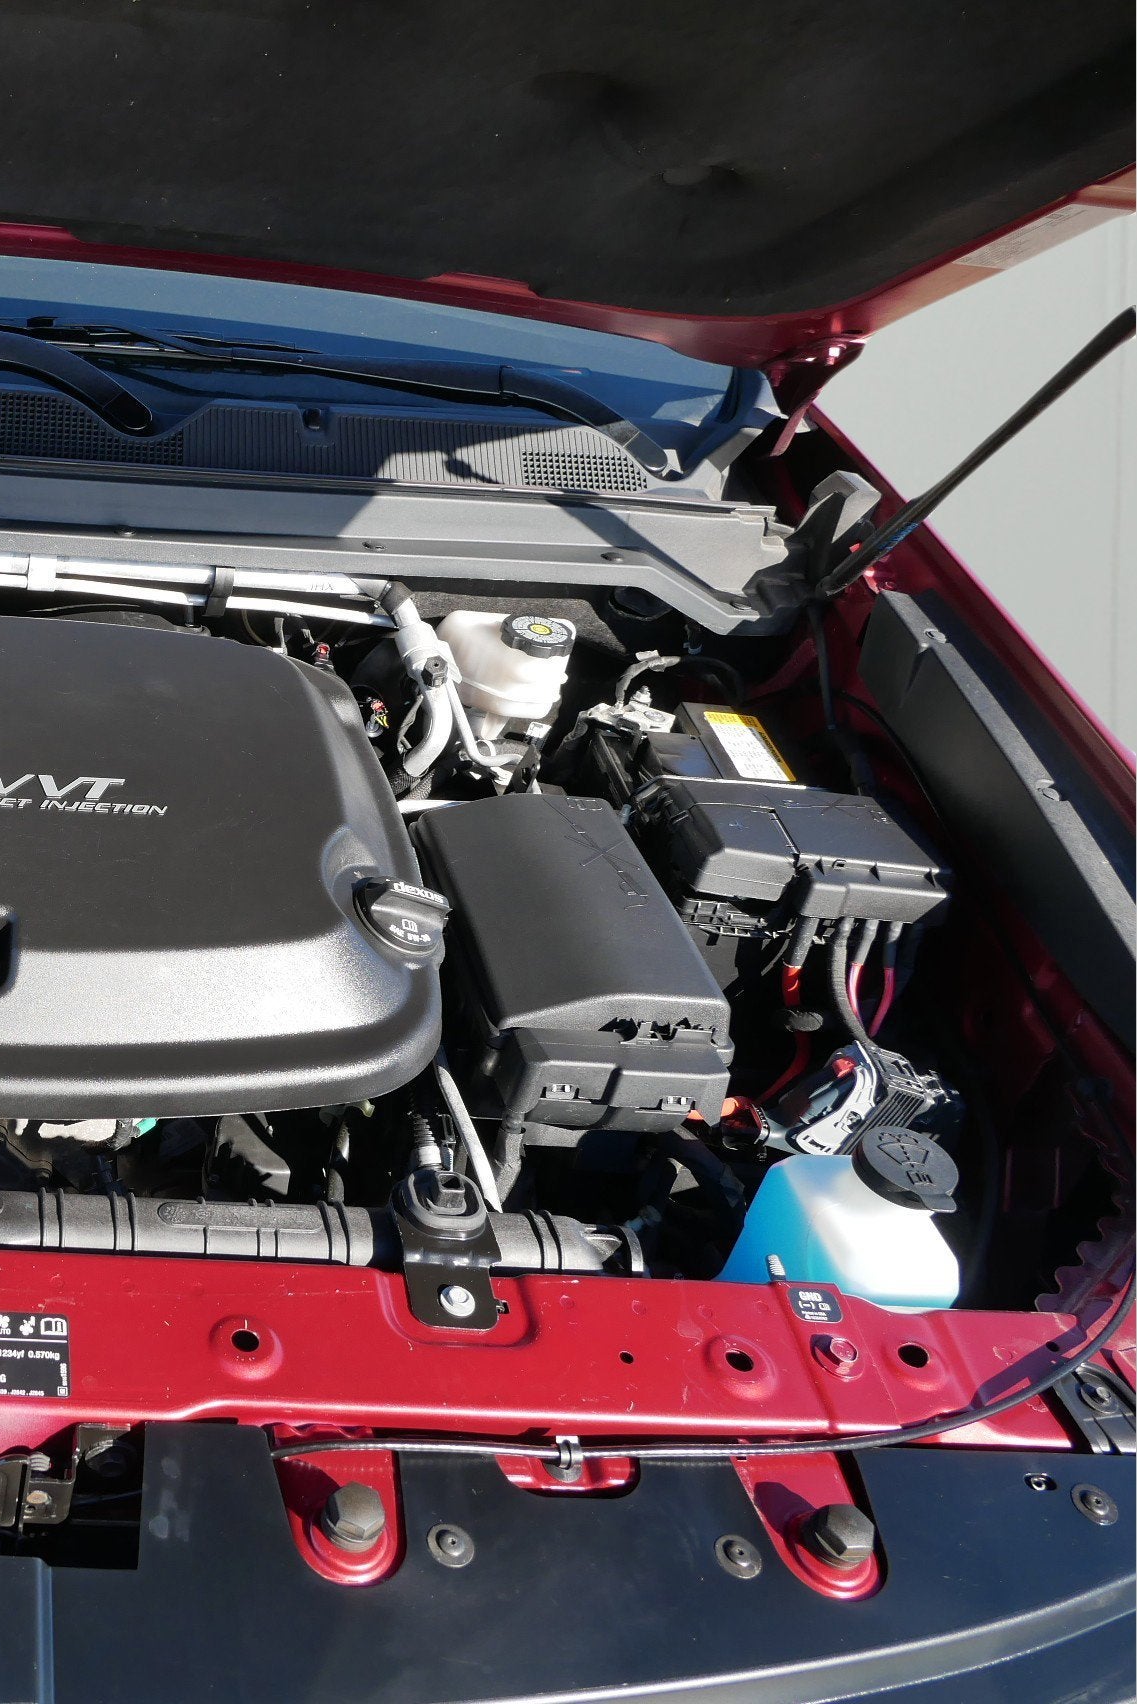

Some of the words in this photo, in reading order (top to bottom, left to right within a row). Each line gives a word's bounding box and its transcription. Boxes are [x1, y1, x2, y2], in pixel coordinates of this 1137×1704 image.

[39, 799, 168, 816] INJECTION
[394, 882, 443, 903] dexos
[799, 1291, 822, 1302] GND
